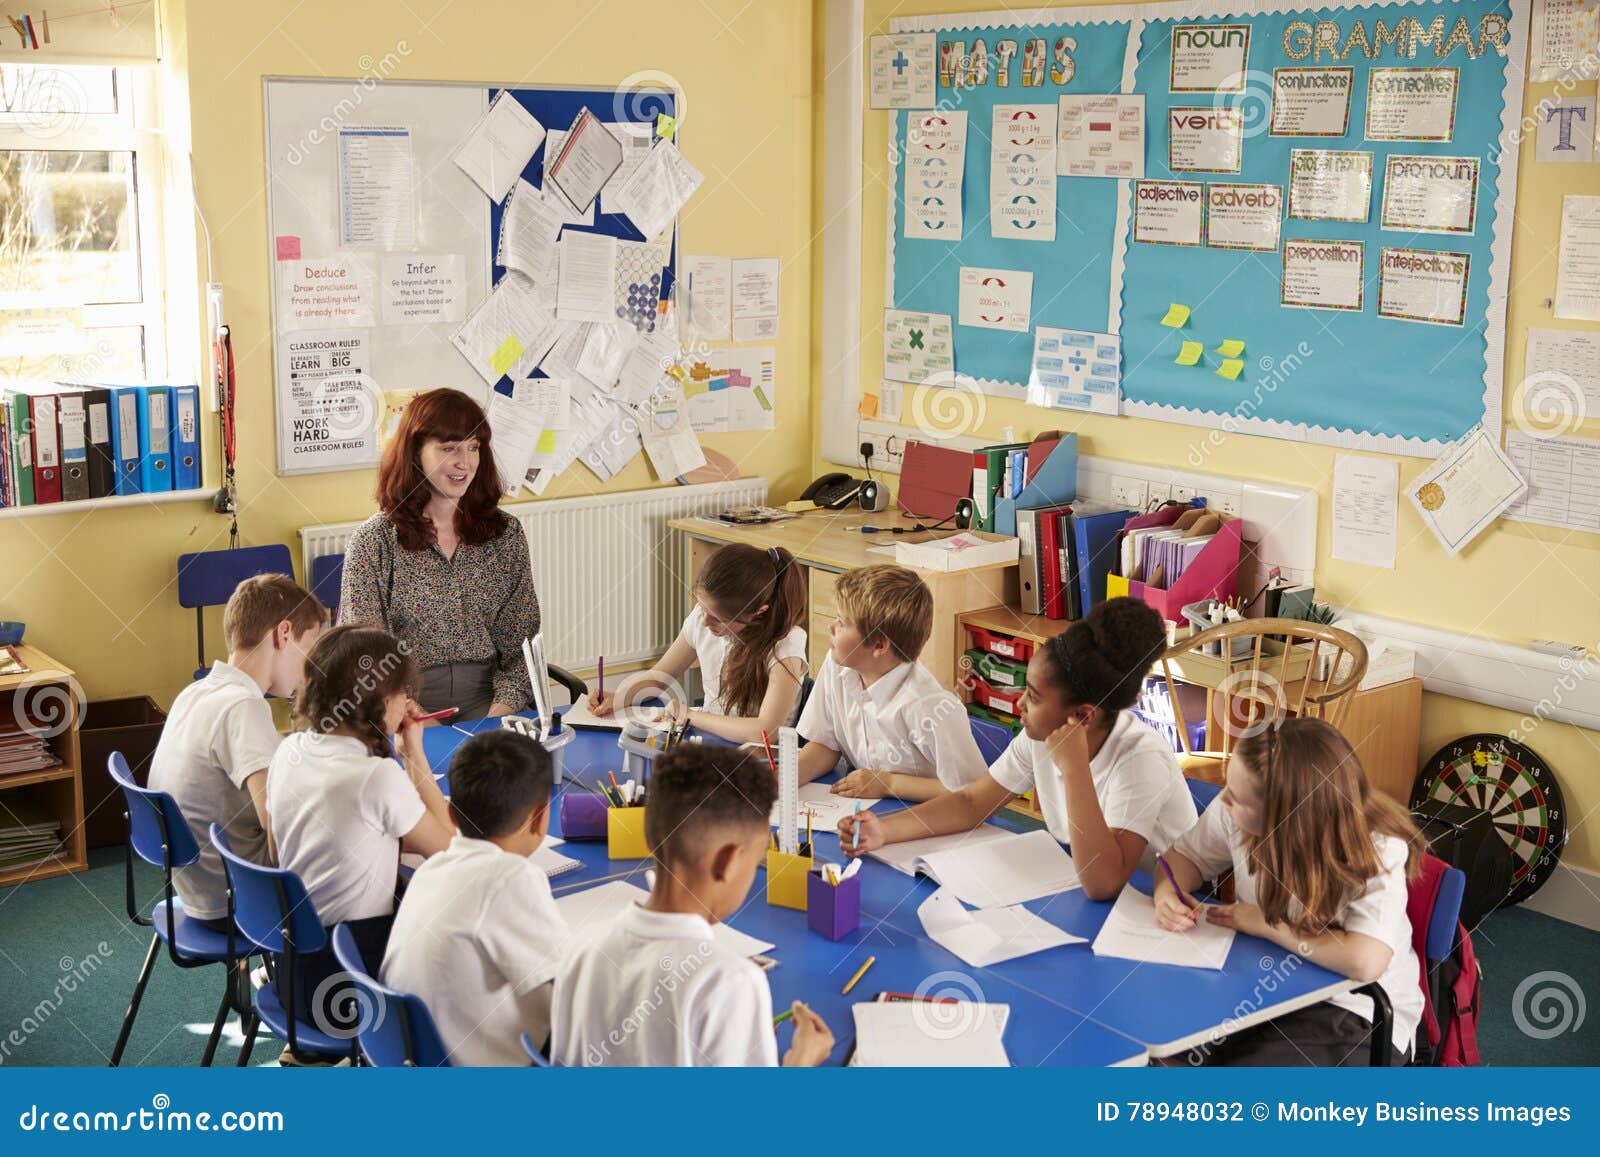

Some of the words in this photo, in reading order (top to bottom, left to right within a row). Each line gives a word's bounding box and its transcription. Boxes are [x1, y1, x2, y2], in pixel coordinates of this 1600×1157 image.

[1176, 30, 1244, 48] noun
[1282, 13, 1508, 62] GRAMMAR
[940, 37, 1078, 88] MATHS
[1278, 73, 1348, 91] conjunctions
[1374, 73, 1452, 93] connectives
[1173, 113, 1237, 130] verb
[1547, 106, 1586, 151] T
[1335, 157, 1368, 173] noun
[1393, 160, 1472, 181] pronoun
[1139, 187, 1199, 202] adjective
[1211, 189, 1277, 207] adverb
[1287, 245, 1359, 263] preposition
[406, 263, 436, 275] Infer
[1385, 252, 1463, 275] interjections
[305, 267, 347, 279] Deduce
[293, 284, 314, 293] Draw
[316, 283, 358, 292] conclusions
[401, 279, 422, 288] beyond
[291, 296, 310, 305] from
[312, 296, 341, 306] reading
[342, 295, 361, 304] what
[304, 307, 333, 318] already
[290, 341, 337, 351] CLASSROOM
[339, 339, 361, 348] RULES!
[291, 360, 321, 370] LEARN
[332, 357, 351, 367] BIG
[293, 417, 329, 430] WORK
[293, 429, 330, 442] HARD
[293, 443, 341, 454] CLASSROOM
[342, 441, 364, 449] RULES!
[1453, 747, 1463, 756] 12
[1476, 742, 1481, 750] 5
[1516, 752, 1521, 761] 1
[1530, 767, 1540, 777] 18
[1423, 778, 1432, 787] 14
[1544, 786, 1550, 795] 4
[1548, 810, 1559, 820] 13
[1540, 855, 1550, 865] 10
[1527, 873, 1537, 883] 15
